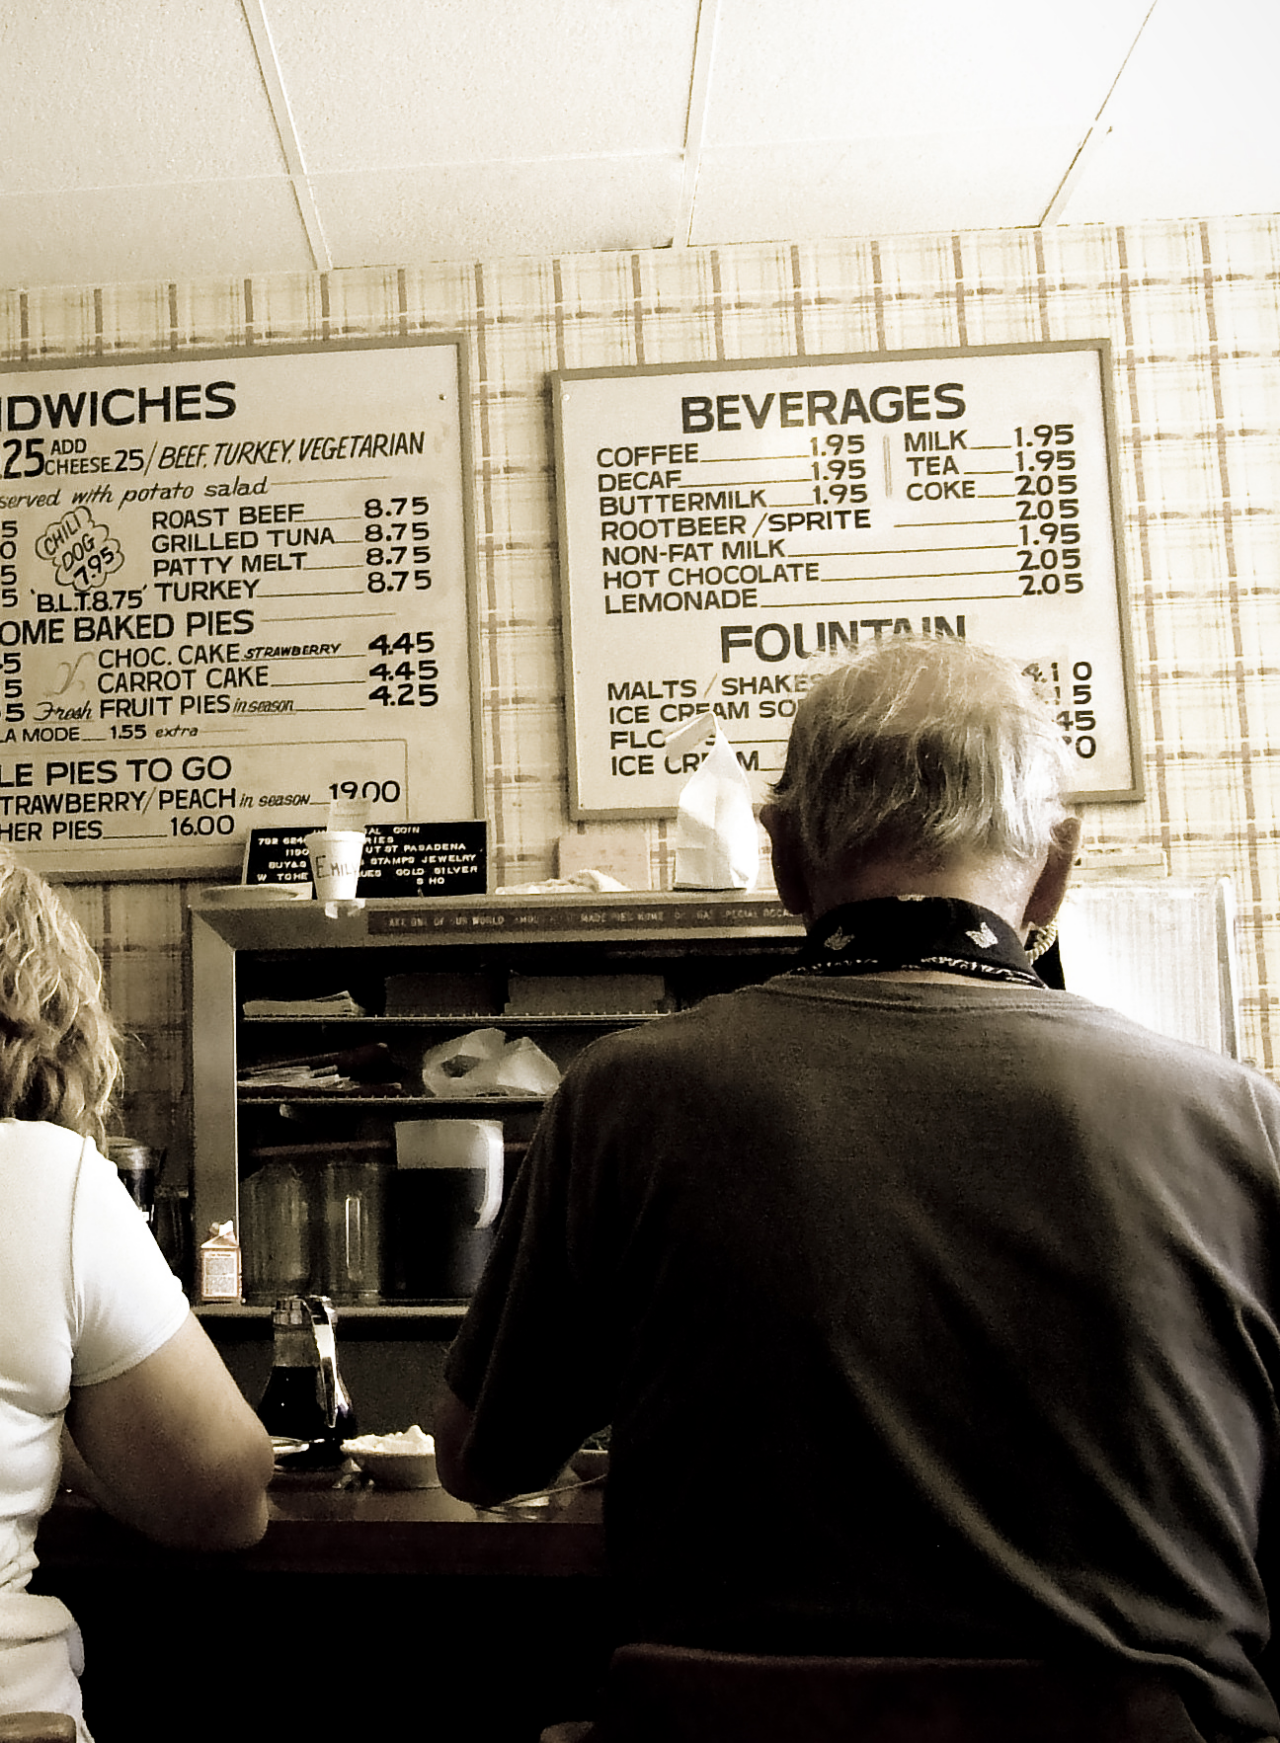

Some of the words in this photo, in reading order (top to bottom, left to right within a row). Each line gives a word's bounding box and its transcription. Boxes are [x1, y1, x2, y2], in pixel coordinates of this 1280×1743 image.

[681, 382, 966, 434] BEVERAGES
[51, 438, 86, 455] ADD
[298, 431, 426, 463] VEGETARIAN
[596, 443, 699, 468] COFFEE
[810, 434, 865, 457] 1.95
[904, 429, 968, 452] MILK
[1014, 424, 1074, 447] 1.95
[598, 469, 682, 492] DECAF
[810, 459, 866, 481] 1.95
[906, 455, 959, 477] TEA
[1015, 450, 1076, 472] 1.95
[71, 483, 114, 505] with
[118, 480, 195, 511] potato
[204, 475, 269, 498] salad
[599, 489, 768, 517] BUTTERMILK
[812, 483, 868, 505] 1.95
[906, 480, 976, 501] COKE
[152, 508, 230, 531] ROAST
[239, 503, 305, 526] BEEF
[364, 496, 430, 519] 8.75
[44, 512, 82, 556] CHILI
[151, 530, 259, 554] GRILLED
[266, 527, 336, 549] TUNA
[364, 521, 430, 543] 8.75
[602, 542, 714, 567] NON-FAT
[722, 538, 786, 560] MILK
[1019, 522, 1081, 546] 1.95
[61, 533, 95, 572] DOG
[72, 546, 115, 586] 7.95
[153, 556, 231, 578] PATTY
[241, 551, 308, 573] MELT
[366, 545, 432, 567] 8.75
[154, 578, 261, 603] TURKEY
[366, 570, 432, 594] 8.75
[603, 569, 660, 590] HOT
[668, 562, 820, 587] CHOCOLATE
[605, 587, 758, 615] LEMONADE
[1018, 573, 1084, 596] 2.05
[73, 613, 175, 643] BAKED
[186, 609, 255, 638] PIES
[720, 614, 966, 664] FOUNTAIN
[98, 645, 172, 669] CHOC.
[178, 643, 241, 666] CAKE
[243, 642, 343, 660] STRAWBERRY
[368, 631, 436, 656] 4.45
[98, 668, 198, 694] CARROT
[205, 665, 270, 689] CAKE
[368, 659, 439, 682] 4.45
[607, 679, 697, 701] MALTS
[32, 699, 93, 722] Fresh
[100, 696, 173, 719] FRUIT
[180, 693, 231, 715] PIES
[368, 683, 439, 707] 4.25
[609, 705, 650, 725] ICE
[22, 727, 81, 742] MODE
[154, 725, 199, 738] extra
[46, 760, 118, 786] PIES
[126, 758, 173, 783] TO
[182, 755, 232, 781] GO
[611, 755, 654, 777] ICE
[239, 793, 254, 808] in
[51, 820, 104, 841] PIES
[170, 815, 235, 837] 16.00
[421, 853, 477, 864] JEWELRY
